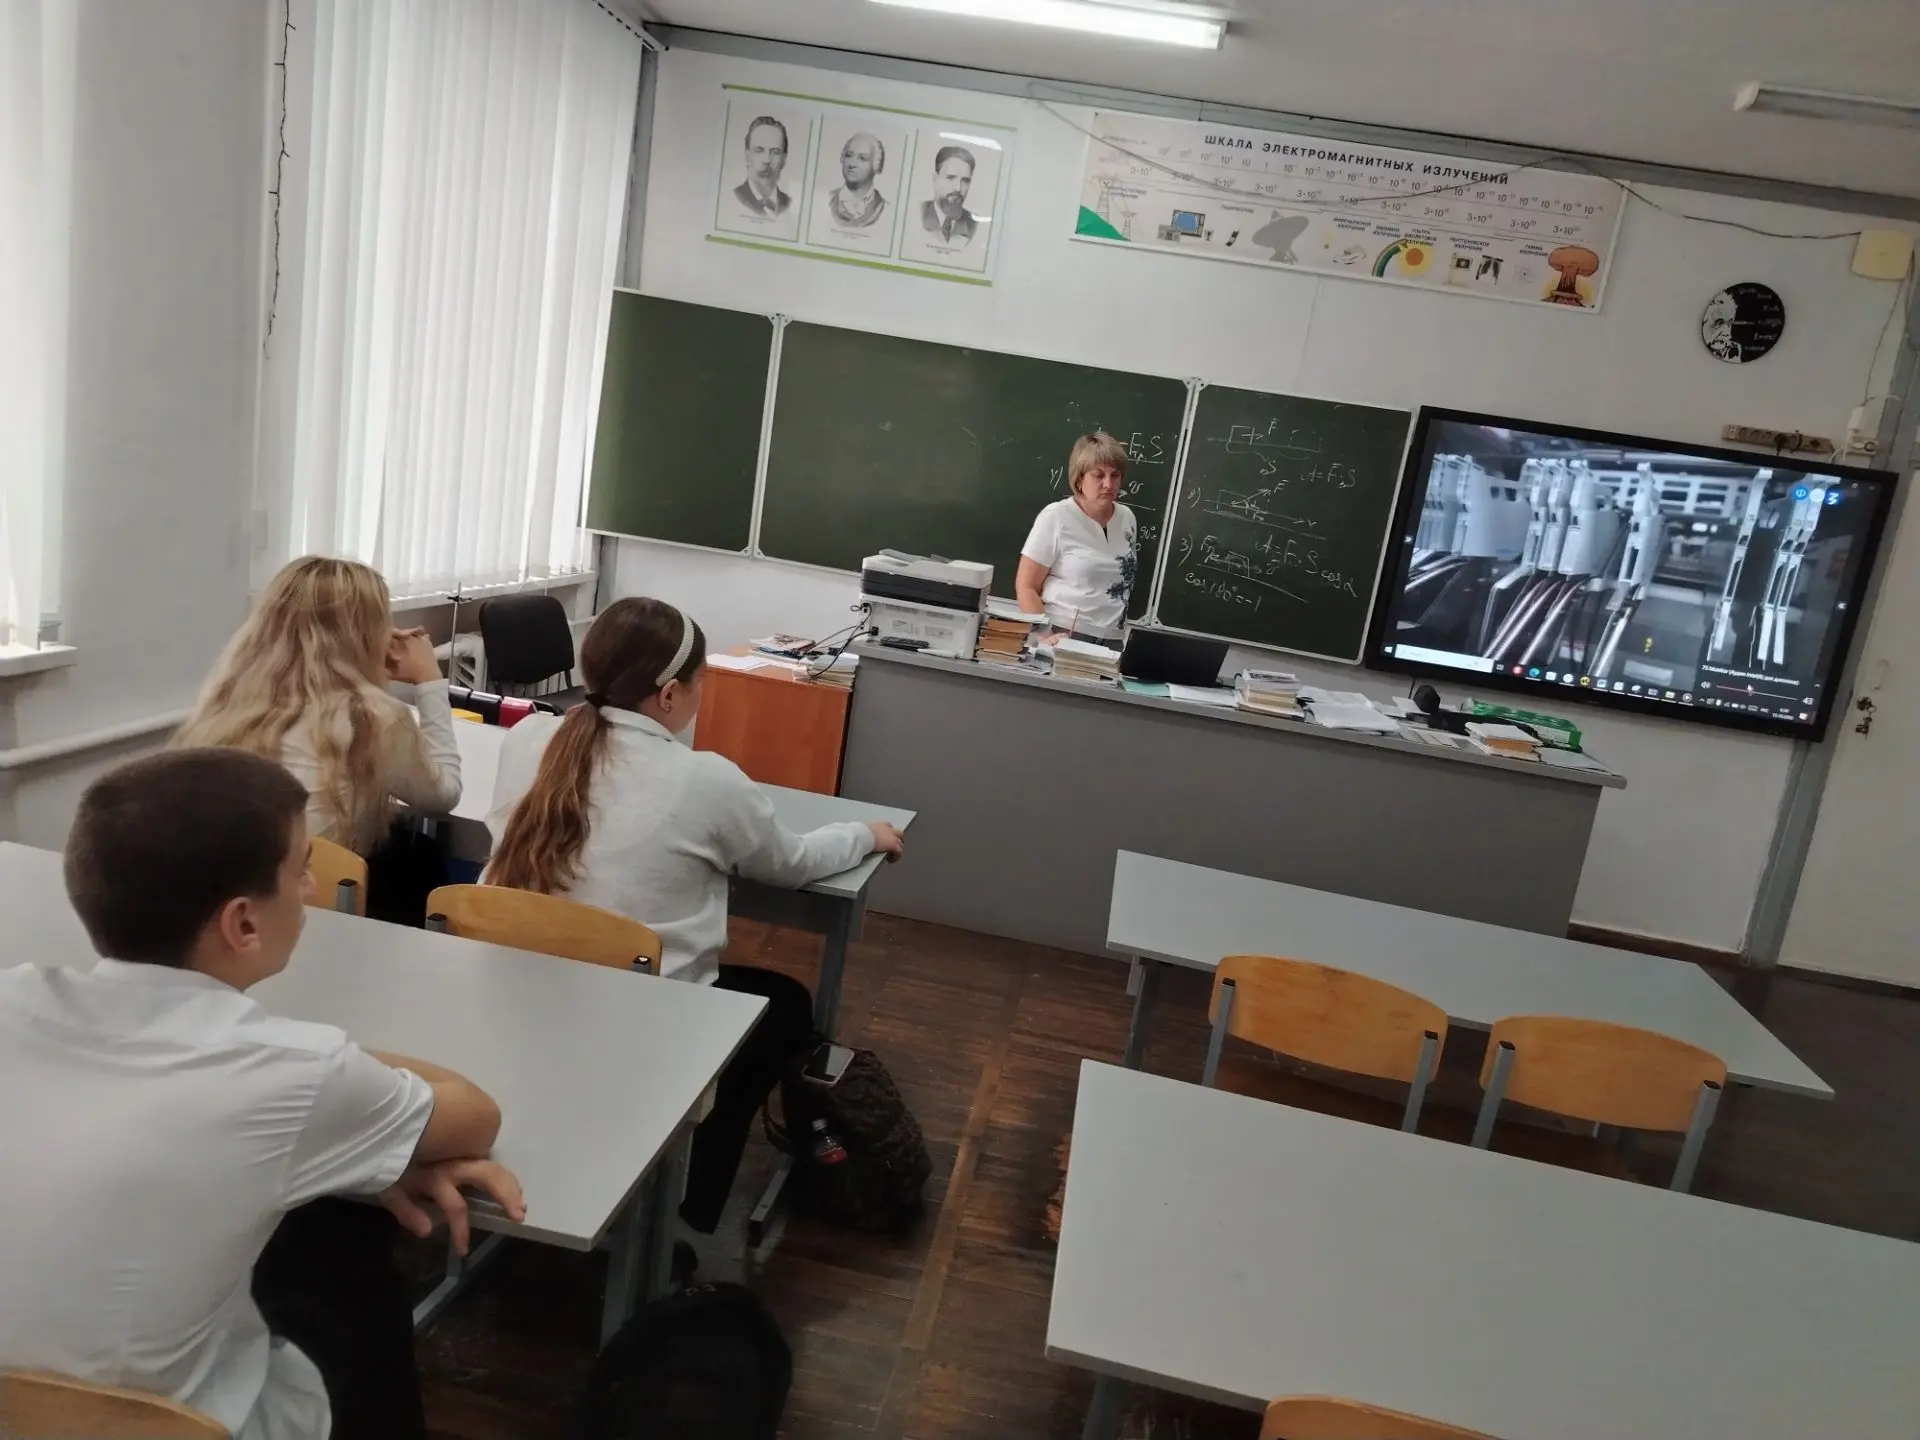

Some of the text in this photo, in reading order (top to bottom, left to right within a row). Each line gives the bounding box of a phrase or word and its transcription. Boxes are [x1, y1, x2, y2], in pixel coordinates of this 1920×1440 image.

[1204, 135, 1508, 185] ШКАЛА ЭЛЕКТРОМАГНИТНЫХ ИЗЛУЧЕНИЙ
